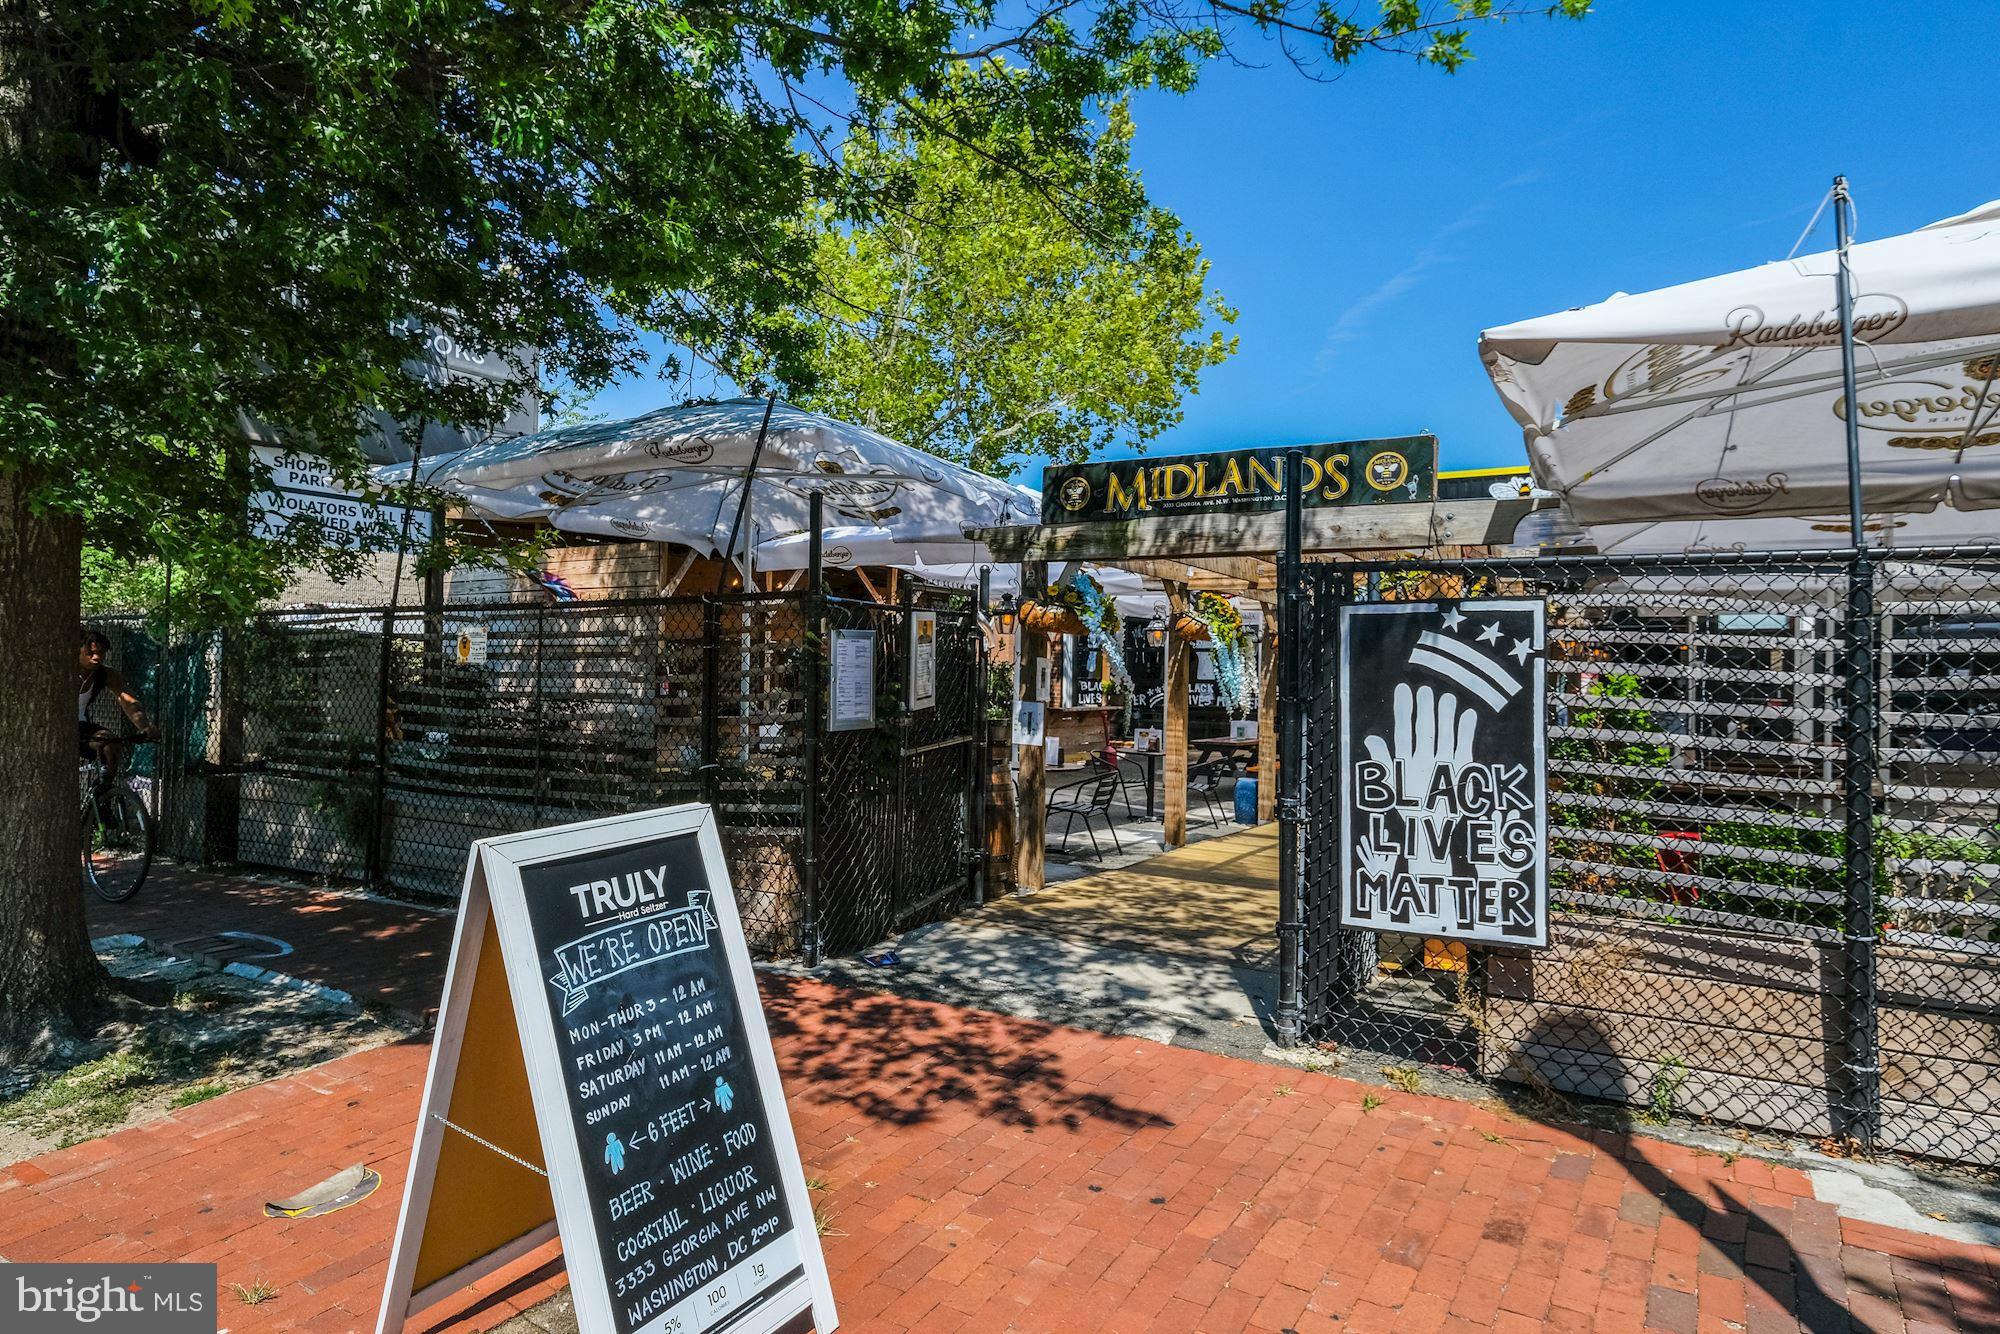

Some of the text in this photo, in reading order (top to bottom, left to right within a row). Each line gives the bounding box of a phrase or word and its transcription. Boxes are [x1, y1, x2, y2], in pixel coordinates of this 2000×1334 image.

[1713, 293, 1909, 352] Radebeger
[268, 495, 357, 517] VIOLATORS
[1104, 454, 1350, 515] MIDLANDS
[1188, 683, 1214, 693] LACK
[1356, 759, 1534, 815] BLACK
[1370, 812, 1537, 872] LIVES
[570, 865, 666, 918] TRULY
[618, 902, 669, 921] Hard Seltzer
[1357, 866, 1535, 926] MATTER
[560, 912, 703, 985] WE'RE OPEN
[568, 1003, 645, 1045] MON-THUR
[646, 998, 656, 1012] 3
[672, 986, 687, 1003] 12
[690, 977, 706, 996] AM
[576, 1039, 623, 1071] FRIDAY
[632, 1032, 643, 1047] 3
[645, 1024, 662, 1041] PM
[678, 1010, 692, 1026] 12
[695, 1000, 713, 1018] AM
[579, 1057, 646, 1099] SATURDAY
[585, 1094, 632, 1126] SUNDAY
[647, 1101, 697, 1142] 6 FEET
[609, 1122, 757, 1222] BEER WINE FOOD
[616, 1165, 758, 1262] COCKTAIL LIQUOR
[727, 1235, 748, 1261] DC
[751, 1215, 779, 1246] 20010
[614, 1185, 777, 1298] 3333 GEORGIA AVE NW
[707, 1285, 727, 1306] 100
[751, 1263, 766, 1278] 1g
[664, 1314, 682, 1334] 5%
